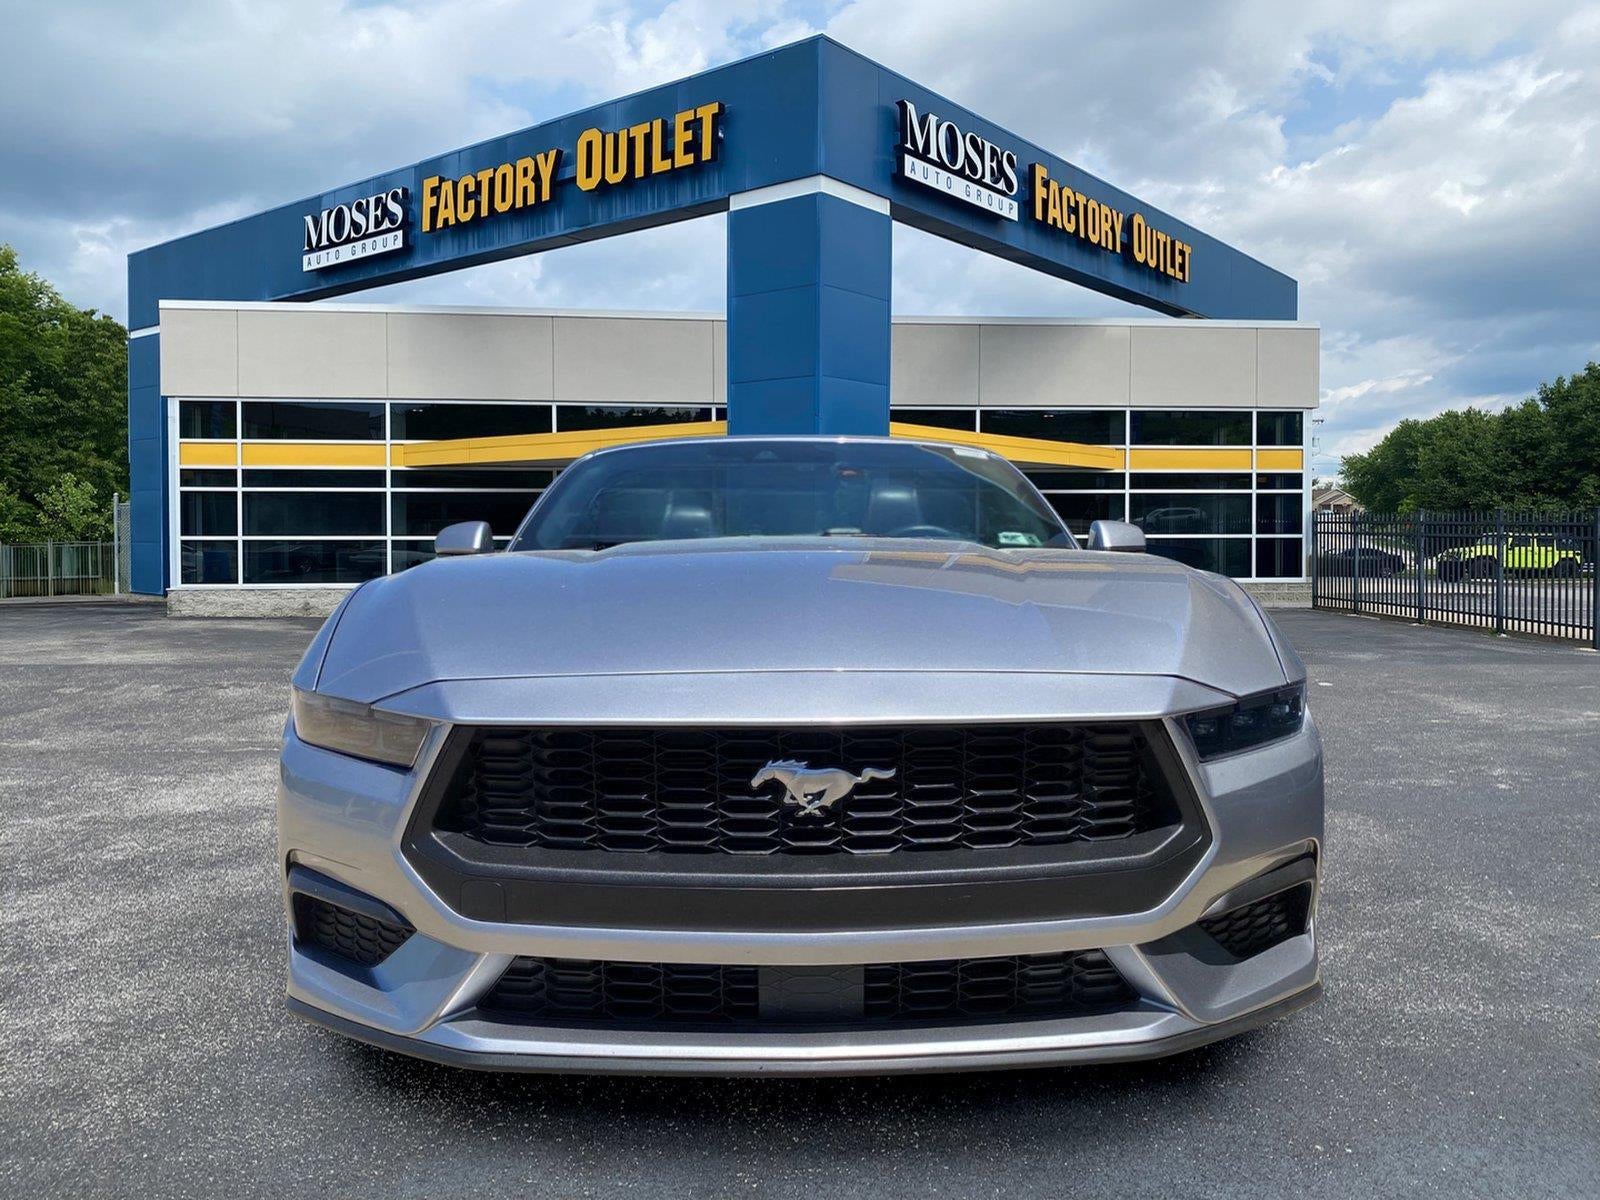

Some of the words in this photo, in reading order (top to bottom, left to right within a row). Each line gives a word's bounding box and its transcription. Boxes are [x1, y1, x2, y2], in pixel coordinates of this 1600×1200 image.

[422, 148, 559, 233] FACTORY
[576, 101, 721, 192] OUTLET
[903, 99, 1018, 196] MOSES
[909, 160, 953, 190] AUTO
[965, 183, 1015, 215] GROUP
[303, 187, 403, 251] MOSES
[306, 248, 341, 268] AUTO
[350, 233, 400, 256] GROUP
[1034, 162, 1124, 254] FACTORY
[1131, 212, 1192, 283] OUTLET
